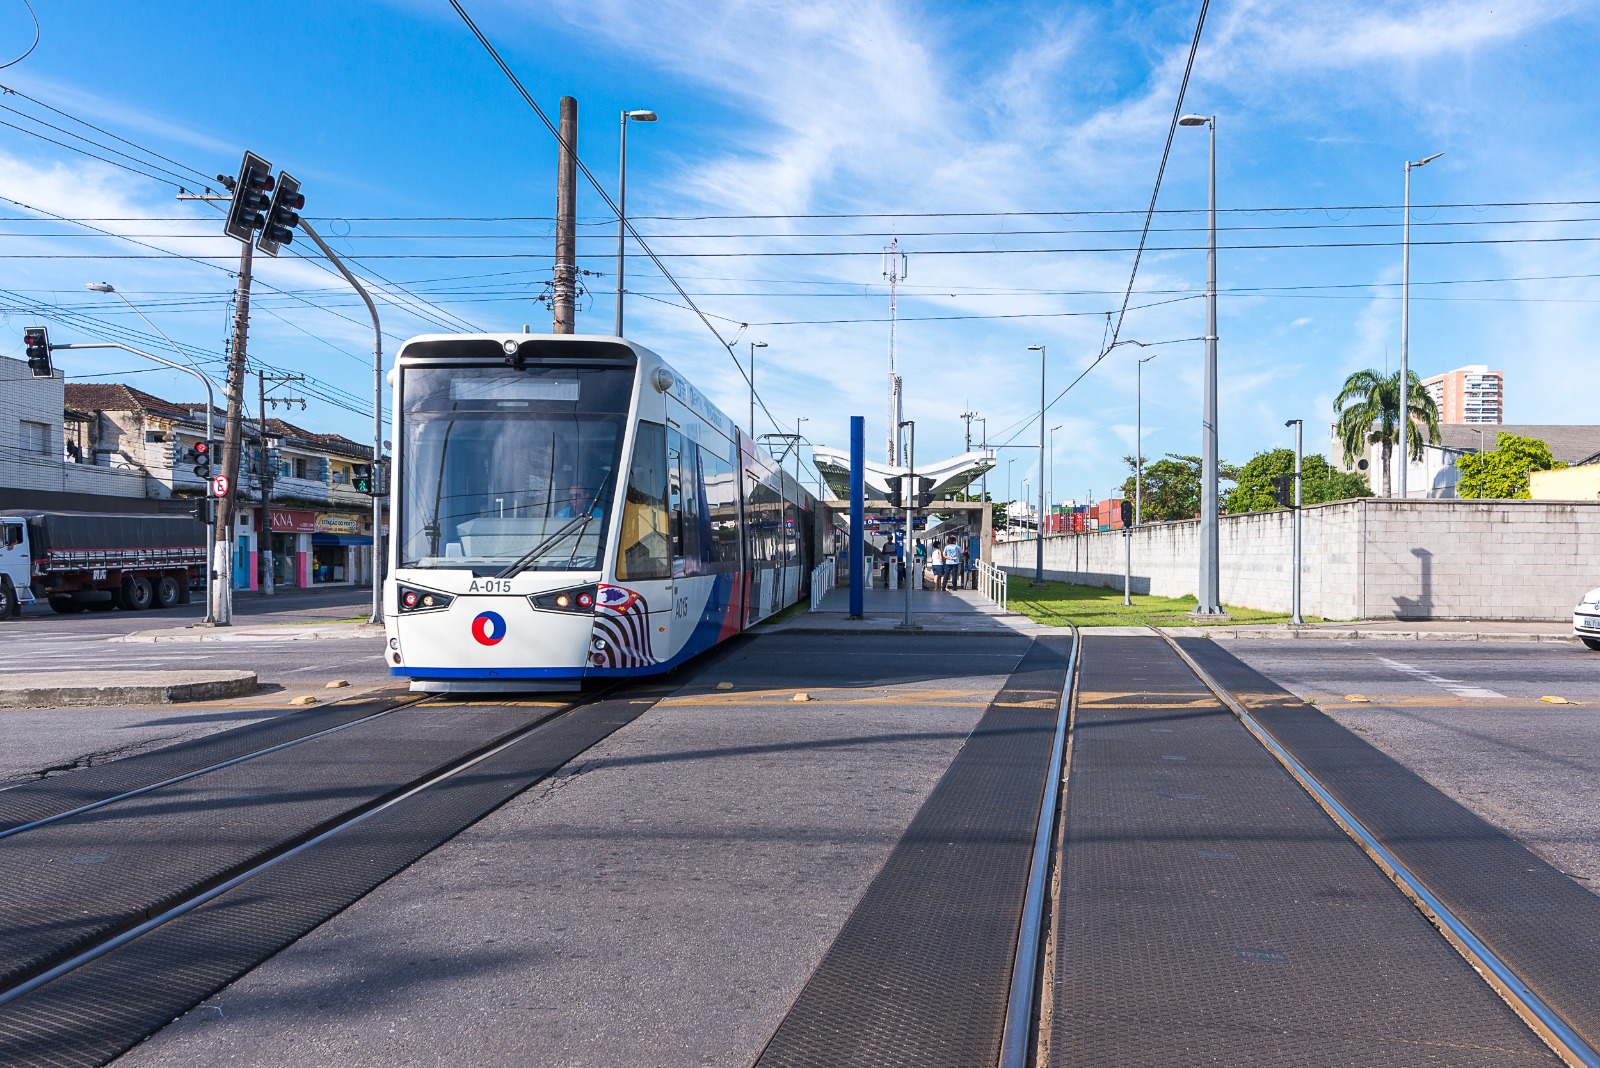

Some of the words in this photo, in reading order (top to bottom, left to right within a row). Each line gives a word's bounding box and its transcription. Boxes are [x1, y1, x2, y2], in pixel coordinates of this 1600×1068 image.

[273, 512, 293, 526] KNA
[469, 580, 511, 593] A-015
[675, 597, 688, 620] A015
